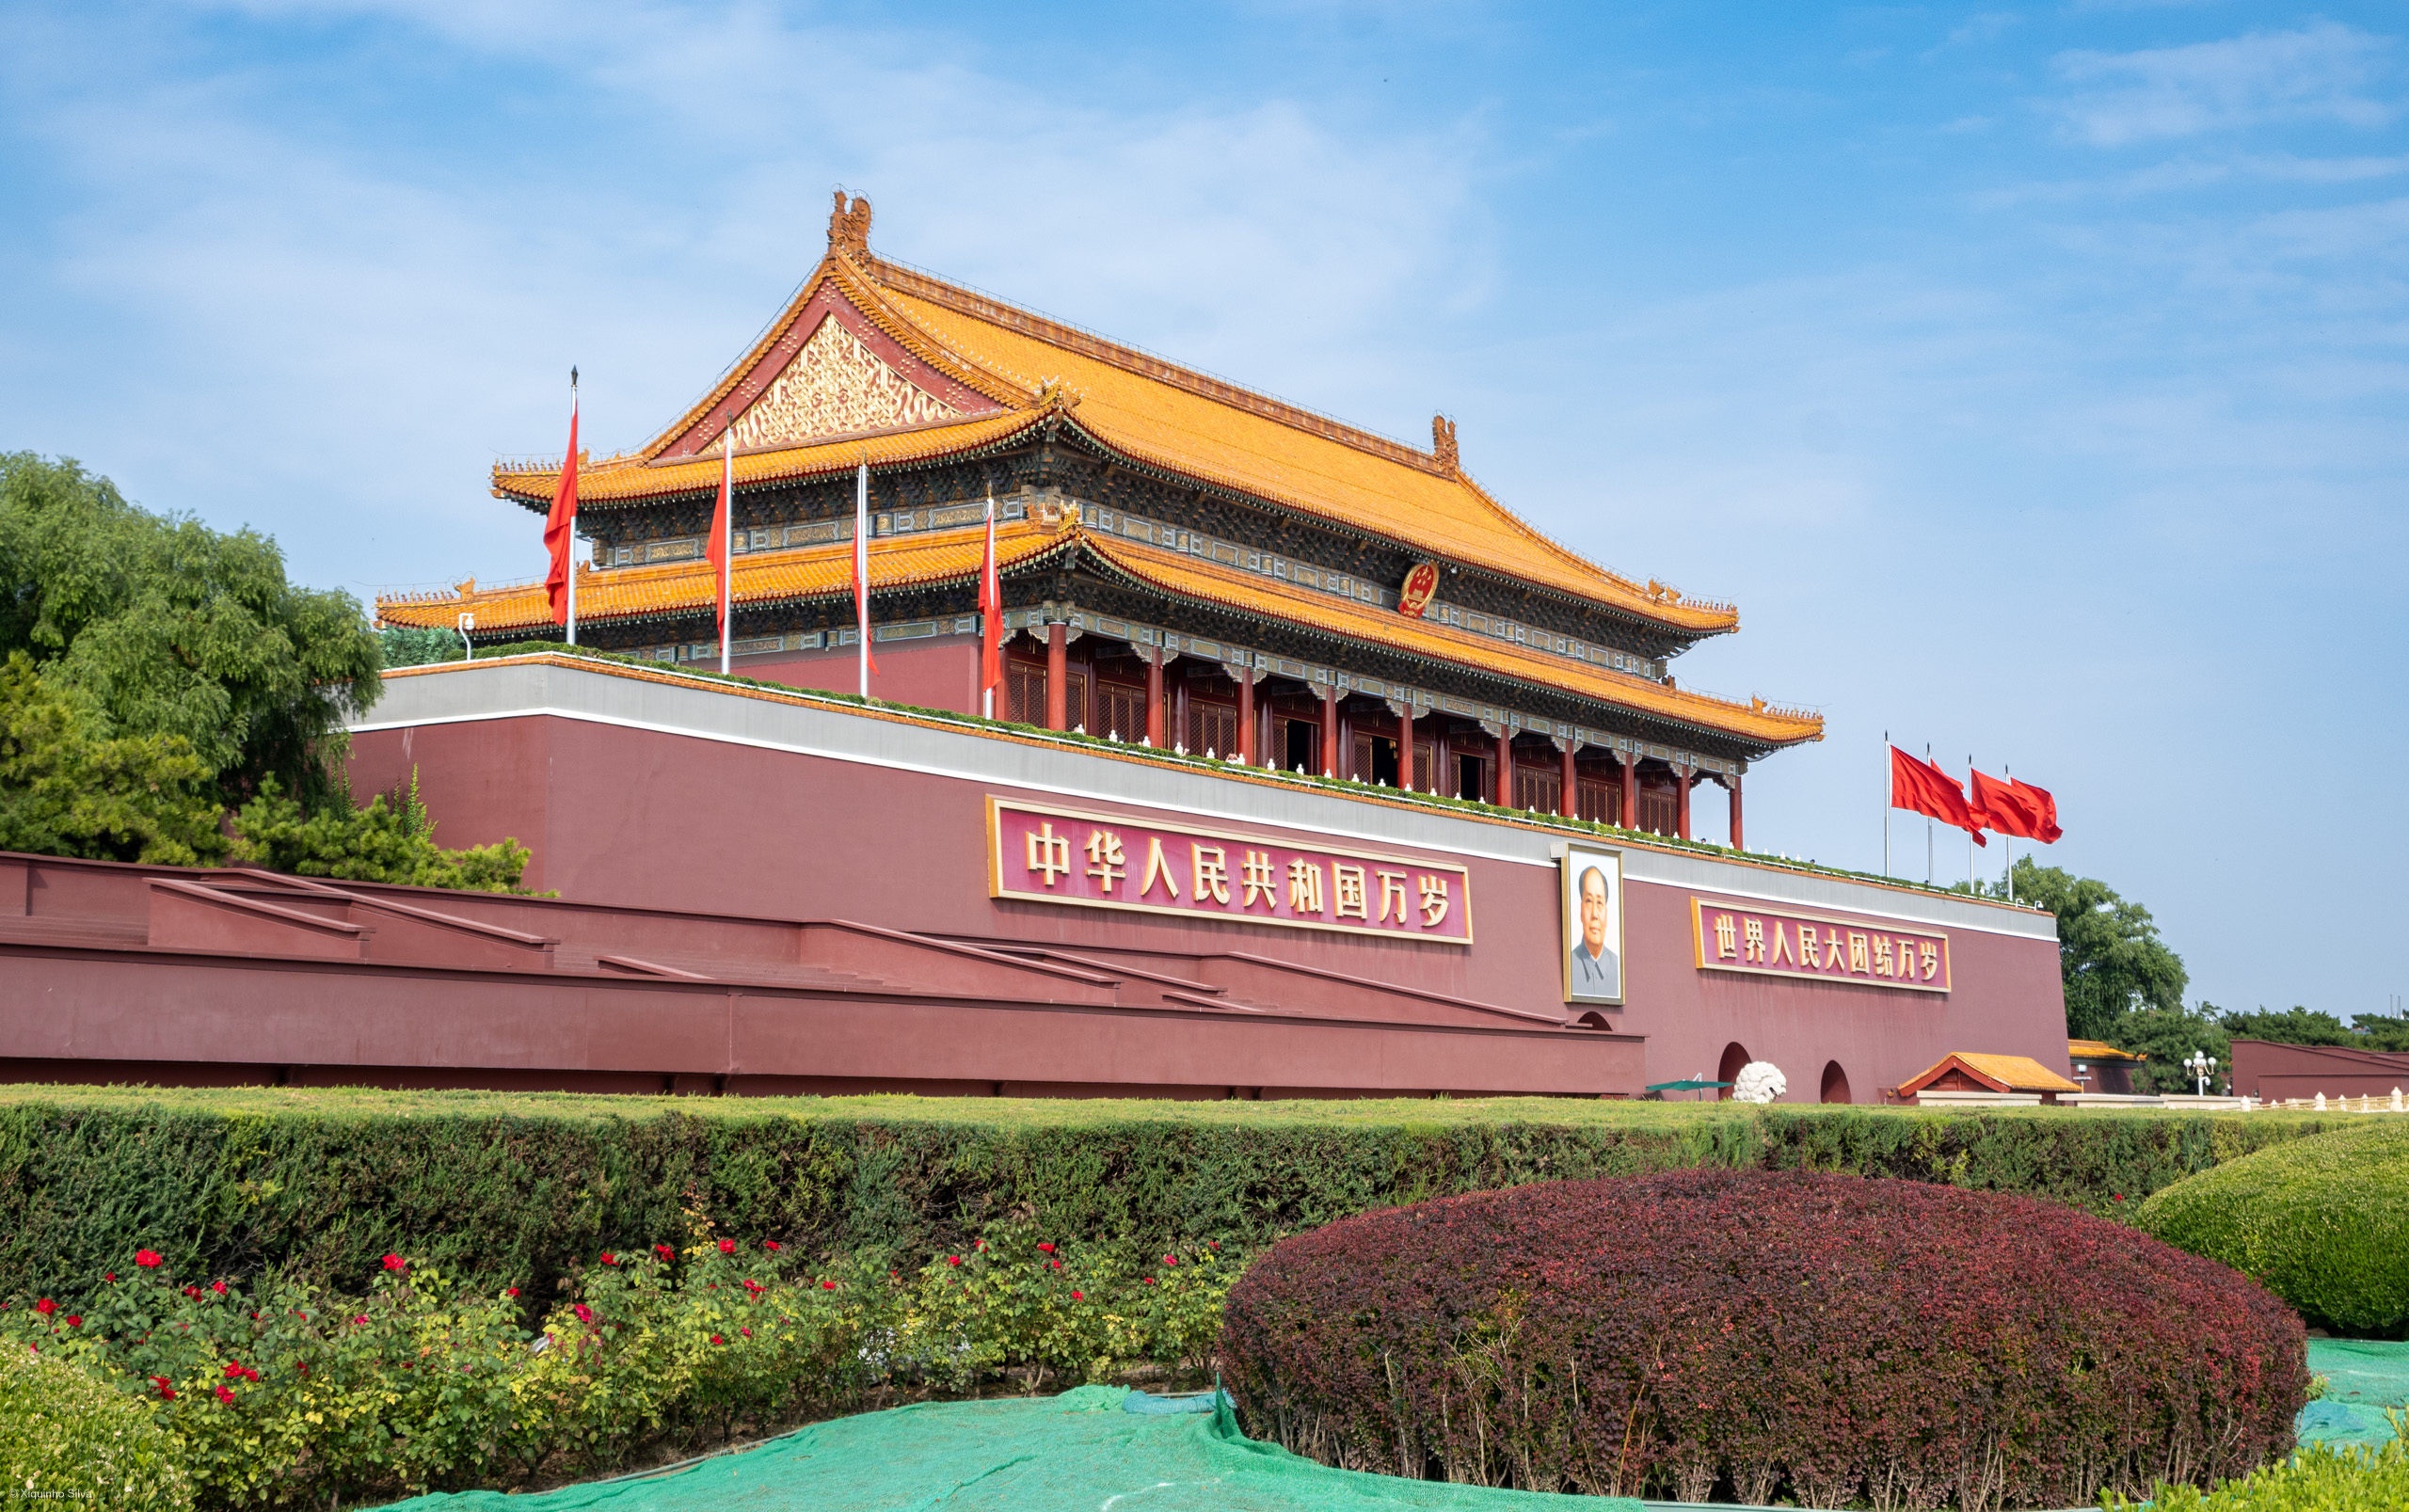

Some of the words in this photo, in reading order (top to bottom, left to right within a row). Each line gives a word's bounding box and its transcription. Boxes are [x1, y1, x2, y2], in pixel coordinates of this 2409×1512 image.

[1026, 821, 1450, 928] 中华人民共和国万岁
[1714, 914, 1938, 980] 世界人民大团结万岁
